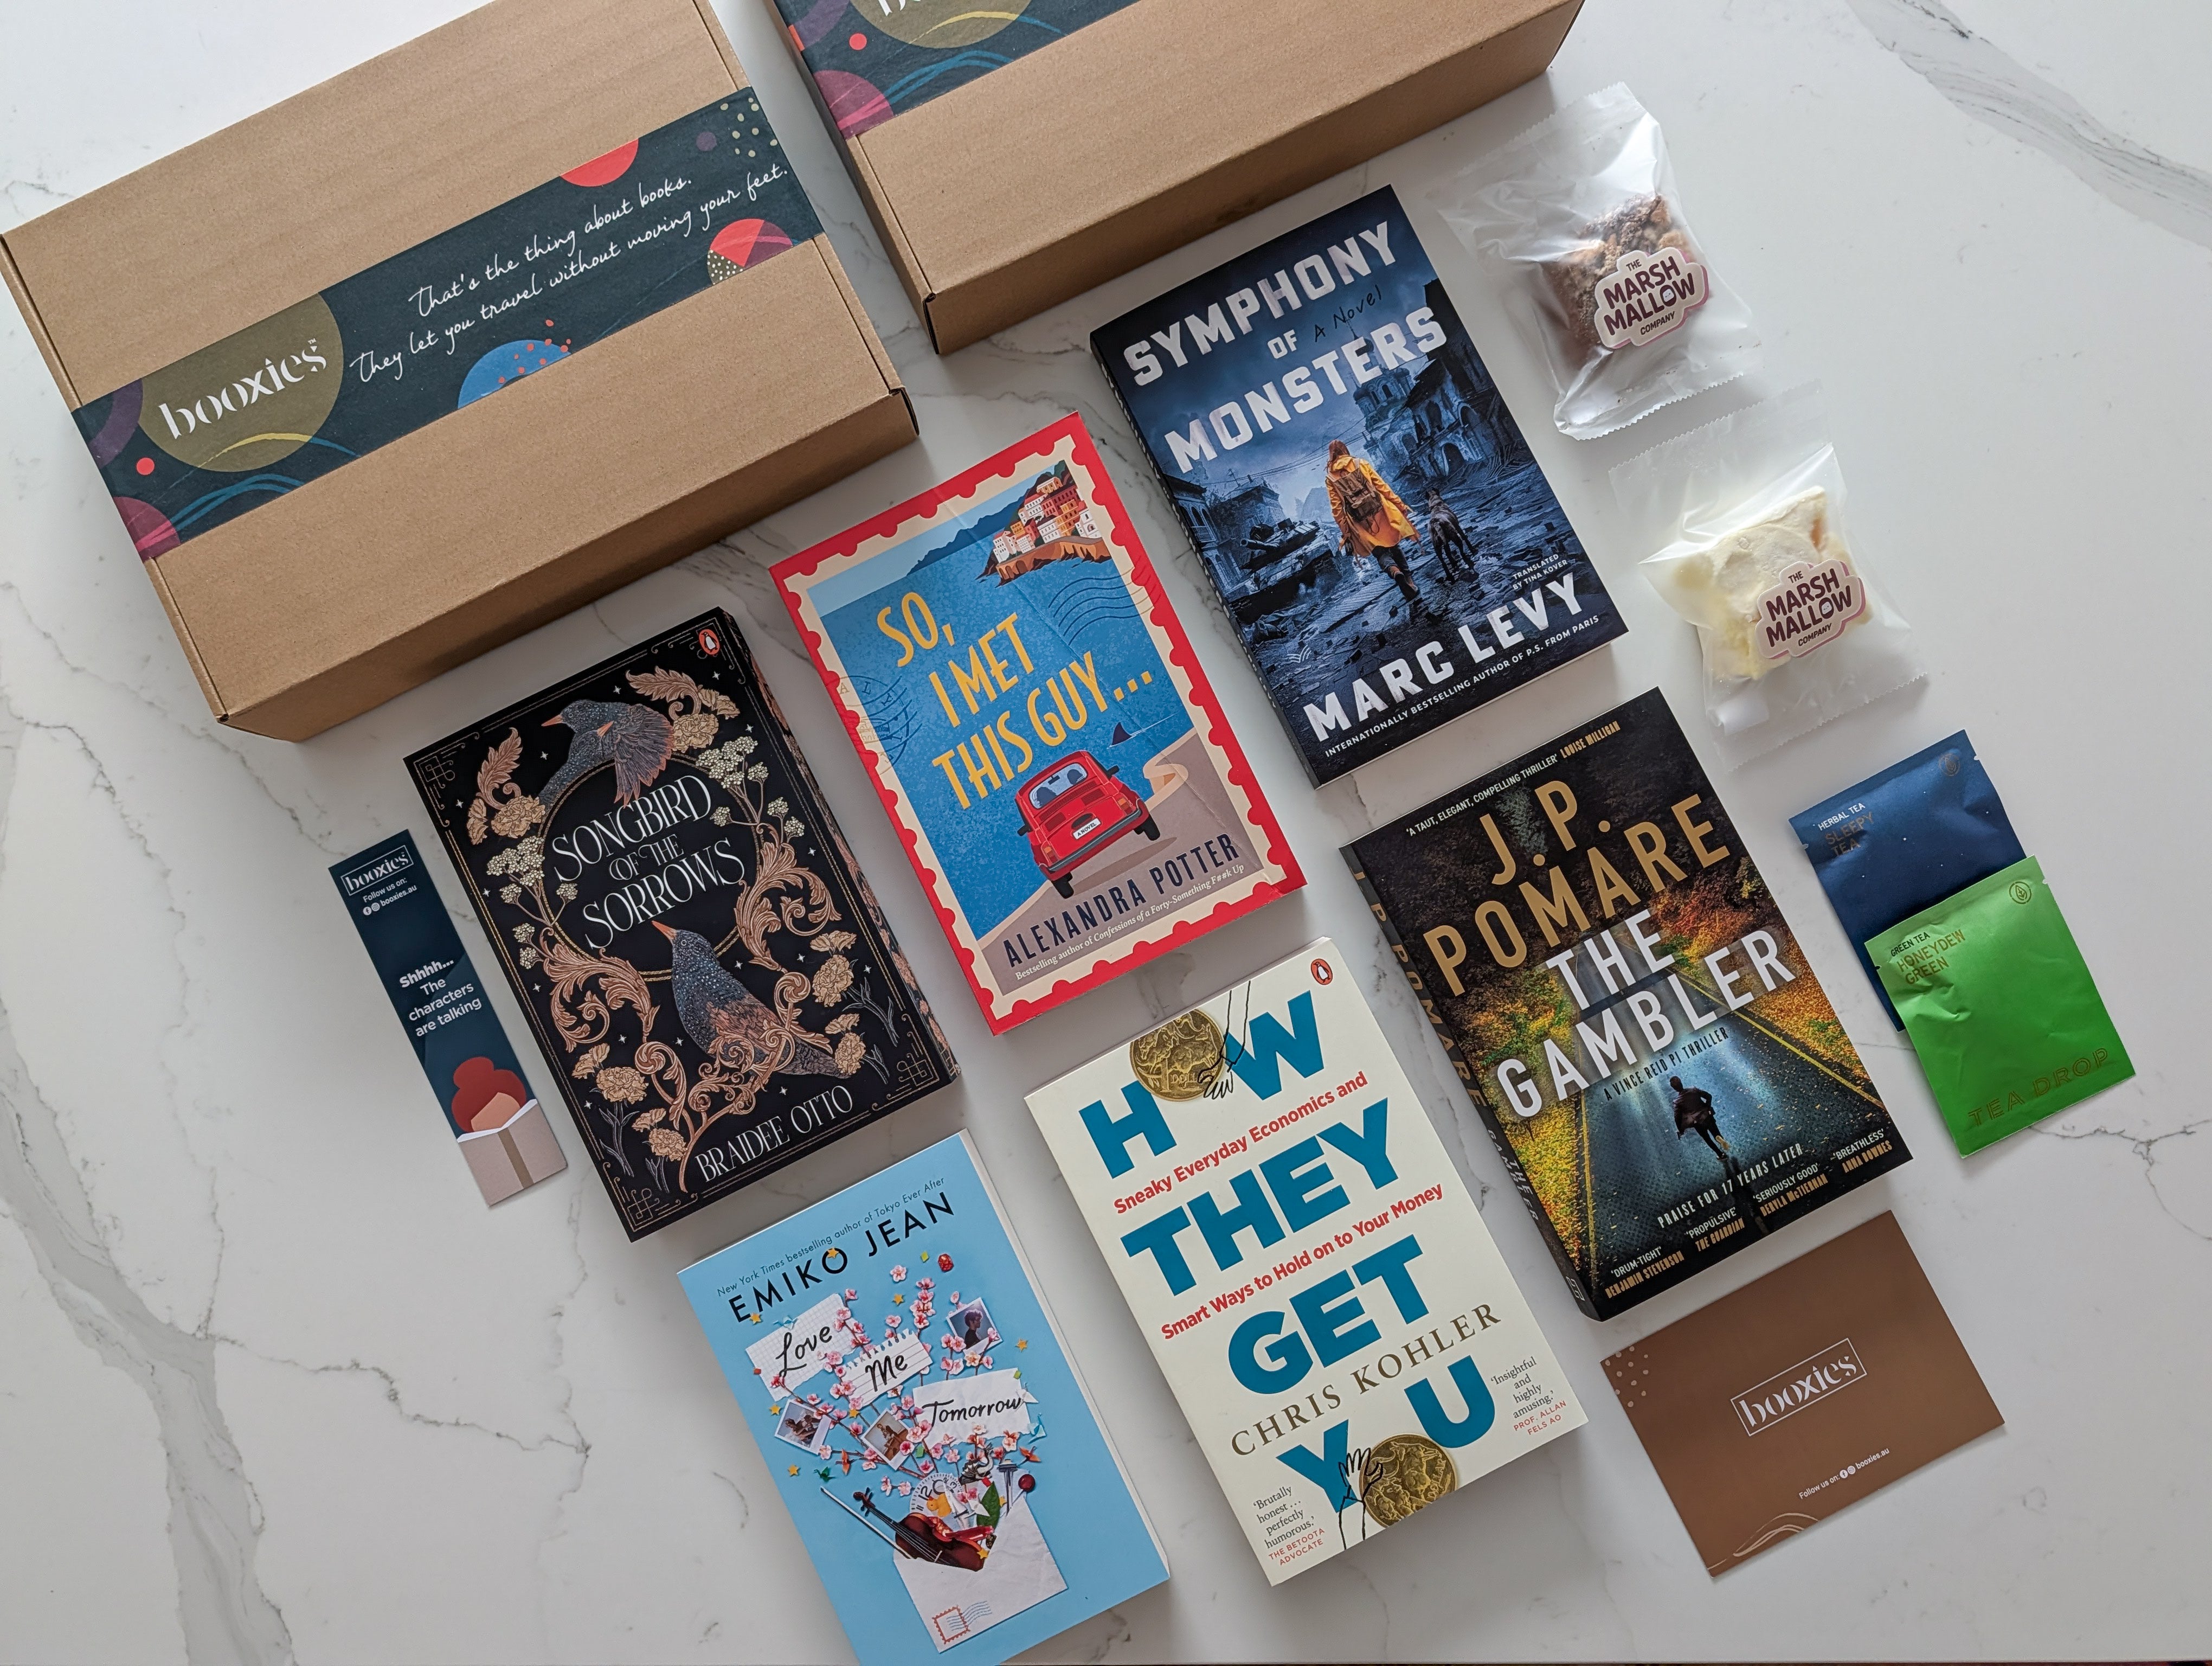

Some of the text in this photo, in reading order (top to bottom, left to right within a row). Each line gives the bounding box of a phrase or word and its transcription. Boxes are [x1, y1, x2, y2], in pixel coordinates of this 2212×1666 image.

[408, 178, 691, 317] That's the thing about books.
[1625, 259, 1642, 272] THE
[349, 163, 787, 382] They let you travel without moving your feet.
[1603, 256, 1681, 310] MARSH
[1123, 221, 1396, 386] SYMPHONY
[1314, 284, 1381, 342] A Novel
[1604, 272, 1695, 336] MALLOW
[1640, 311, 1675, 335] COMPANY
[1267, 329, 1297, 359] OF
[158, 345, 326, 439] booxies
[1165, 306, 1446, 473] MONSTERS
[1512, 554, 1559, 580] TRANSLATED
[1513, 559, 1568, 591] BY TINA KOVER
[1787, 571, 1804, 584] THE
[1766, 568, 1840, 621] MARSH
[1766, 585, 1852, 648] MALLOW
[877, 592, 955, 667] SO,
[1798, 623, 1832, 647] COMPANY
[929, 672, 960, 727] I
[948, 613, 1034, 714] MET
[1303, 572, 1582, 742] MARC LEVY
[1325, 710, 1408, 758] INTERNATIONALLY
[1410, 680, 1471, 714] BESTSELLING
[1473, 660, 1510, 683] AUTHOR
[1512, 652, 1523, 663] OF
[1526, 644, 1544, 656] P.S.
[1545, 629, 1571, 647] FROM
[1572, 615, 1599, 633] PARIS
[932, 651, 1152, 809] THIS GUY...
[1414, 816, 1438, 832] TAUT,
[1437, 798, 1474, 821] ELEGANT,
[1473, 773, 1521, 803] COMPELLING
[1520, 753, 1558, 778] THRILLER'
[552, 775, 711, 888] SONGBIRD
[1818, 803, 1866, 831] HERBAL TEA
[345, 854, 409, 891] booxies
[609, 834, 684, 880] OF THE
[363, 877, 407, 903] Follow us on:
[380, 885, 417, 907] booxies.au
[583, 837, 745, 951] SORROWS
[1003, 834, 1239, 968] ALEXANDRA POTTER
[1423, 793, 1731, 997] POMARE
[1015, 956, 1058, 981] Bestselling
[1058, 943, 1084, 960] author
[1084, 935, 1094, 946] of
[1094, 917, 1136, 941] Confessions
[1136, 910, 1144, 922] of
[1150, 880, 1211, 914] Forty-Something
[1232, 864, 1244, 874] Up
[1891, 932, 1931, 957] GREEN TEA
[1545, 909, 1675, 1010] THE
[1894, 928, 1967, 973] HONEYDEW
[1902, 954, 1951, 987] GREEN
[399, 960, 454, 988] Shhhh...
[420, 979, 446, 995] The
[409, 983, 474, 1021] characters
[415, 998, 482, 1036] are talking
[1497, 930, 1796, 1117] GAMBLER
[1604, 1027, 1729, 1101] A VINCE REID PI THRILLER
[1966, 1046, 2113, 1129] TEA DROP
[695, 1085, 853, 1182] BRAIDEE OTTO
[1114, 1071, 1368, 1214] Sneaky Everyday Economics and
[1832, 1128, 1884, 1160] 'BREATHLESS'
[1120, 1097, 1399, 1297] THEY
[1657, 1143, 1803, 1228] PRAISE FOR 17 YEARS LATER
[1753, 1162, 1818, 1202] 'SERIOUSLY GOOD'
[717, 1178, 944, 1297] New York Times bestselling author of Tokyo Ever After
[1686, 1207, 1737, 1239] 'PROPULSIVE'
[728, 1191, 954, 1322] EMIKO JEAN
[1161, 1183, 1443, 1340] Smart Ways to Hold on to Your Money
[1611, 1246, 1662, 1278] 'DRUM-TIGHT'
[1228, 1234, 1429, 1394] GET
[775, 1327, 832, 1377] Love
[865, 1355, 908, 1393] Me
[1490, 1356, 1537, 1385] 'Insightful
[1232, 1304, 1501, 1456] CHRIS KOHLER
[1513, 1384, 1541, 1404] highly
[1514, 1373, 1532, 1389] and
[1739, 1356, 1856, 1427] booxies
[922, 1398, 1021, 1427] Tomorrow
[1513, 1390, 1553, 1419] amusing.'
[1513, 1400, 1566, 1431] PROF. ALLAN
[1527, 1414, 1561, 1436] FELS AO
[1253, 1486, 1291, 1510] 'Brutally
[1256, 1503, 1288, 1524] honest
[1264, 1516, 1314, 1549] humorous.'
[1266, 1509, 1303, 1536] perfectly
[1268, 1528, 1325, 1560] THE BETOOTA
[1280, 1538, 1323, 1566] ADVOCATE
